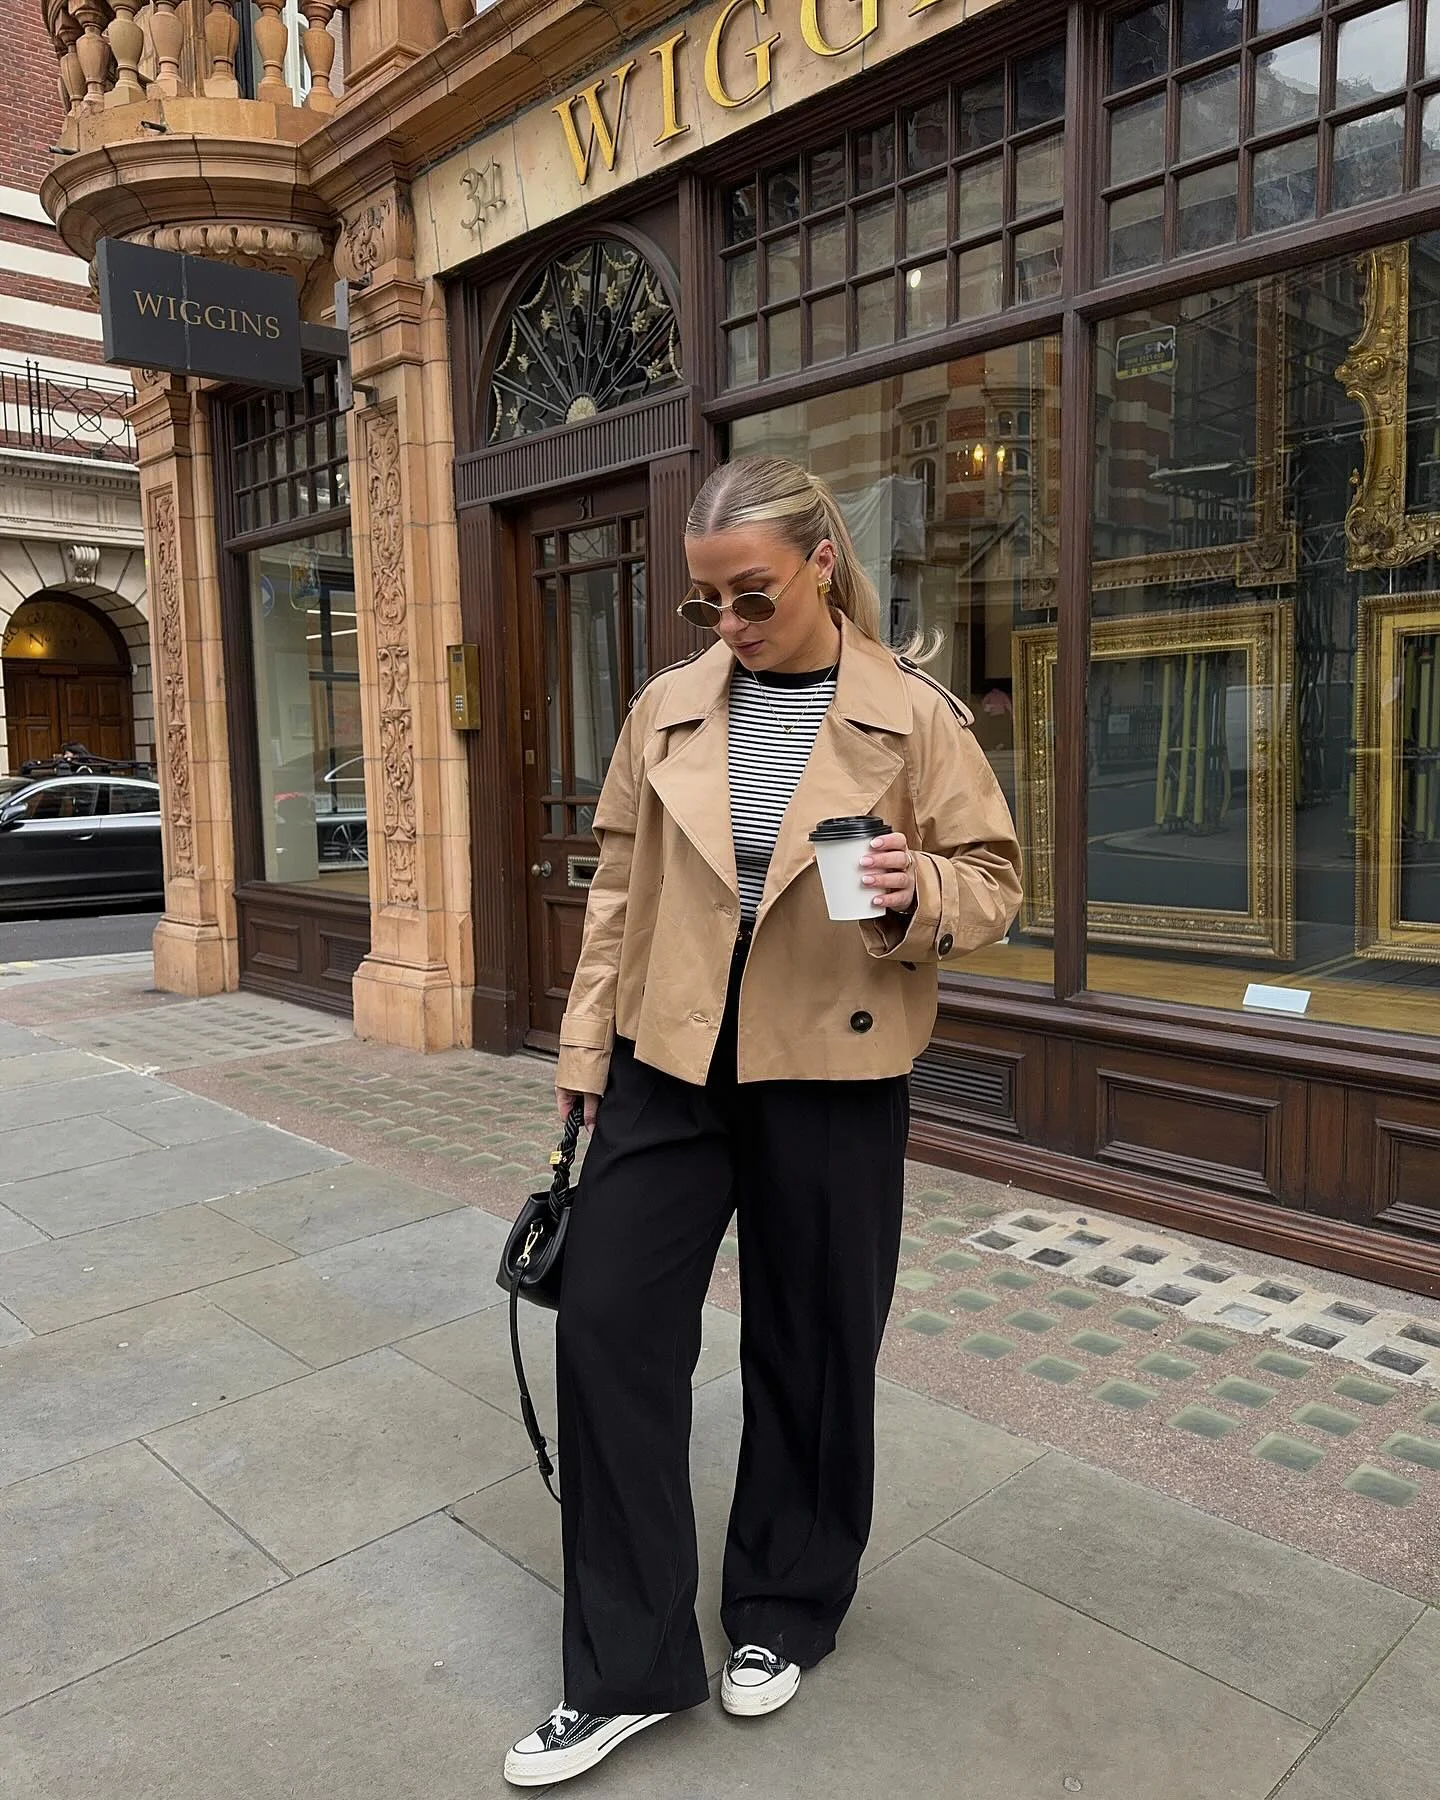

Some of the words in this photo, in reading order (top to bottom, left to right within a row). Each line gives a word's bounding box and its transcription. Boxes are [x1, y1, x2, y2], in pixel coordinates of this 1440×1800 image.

[552, 0, 941, 186] WIGG
[459, 154, 504, 229] 31
[133, 290, 280, 340] WIGGINS
[574, 494, 593, 521] 31
